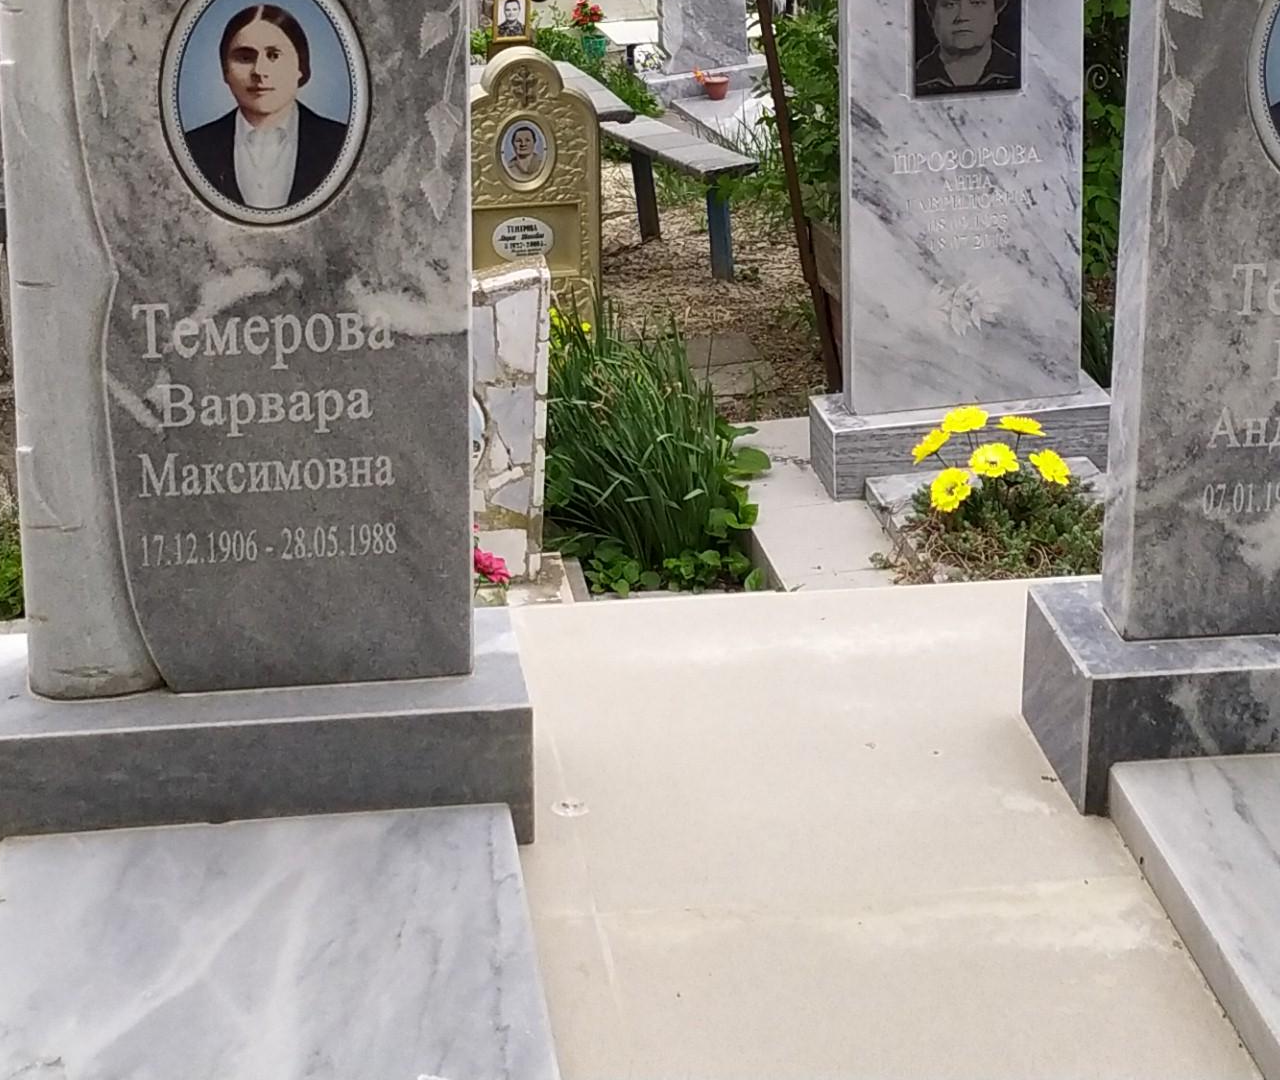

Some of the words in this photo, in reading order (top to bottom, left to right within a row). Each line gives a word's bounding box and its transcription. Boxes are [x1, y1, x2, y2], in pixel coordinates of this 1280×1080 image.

[891, 144, 1044, 175] ПРОЗОРОВА
[943, 173, 995, 193] АННА
[131, 302, 395, 370] Темерова
[156, 383, 374, 437] Варвара
[137, 452, 396, 499] Максимовна
[139, 528, 258, 568] 17.12.1906
[280, 521, 398, 561] 28.05.1988
